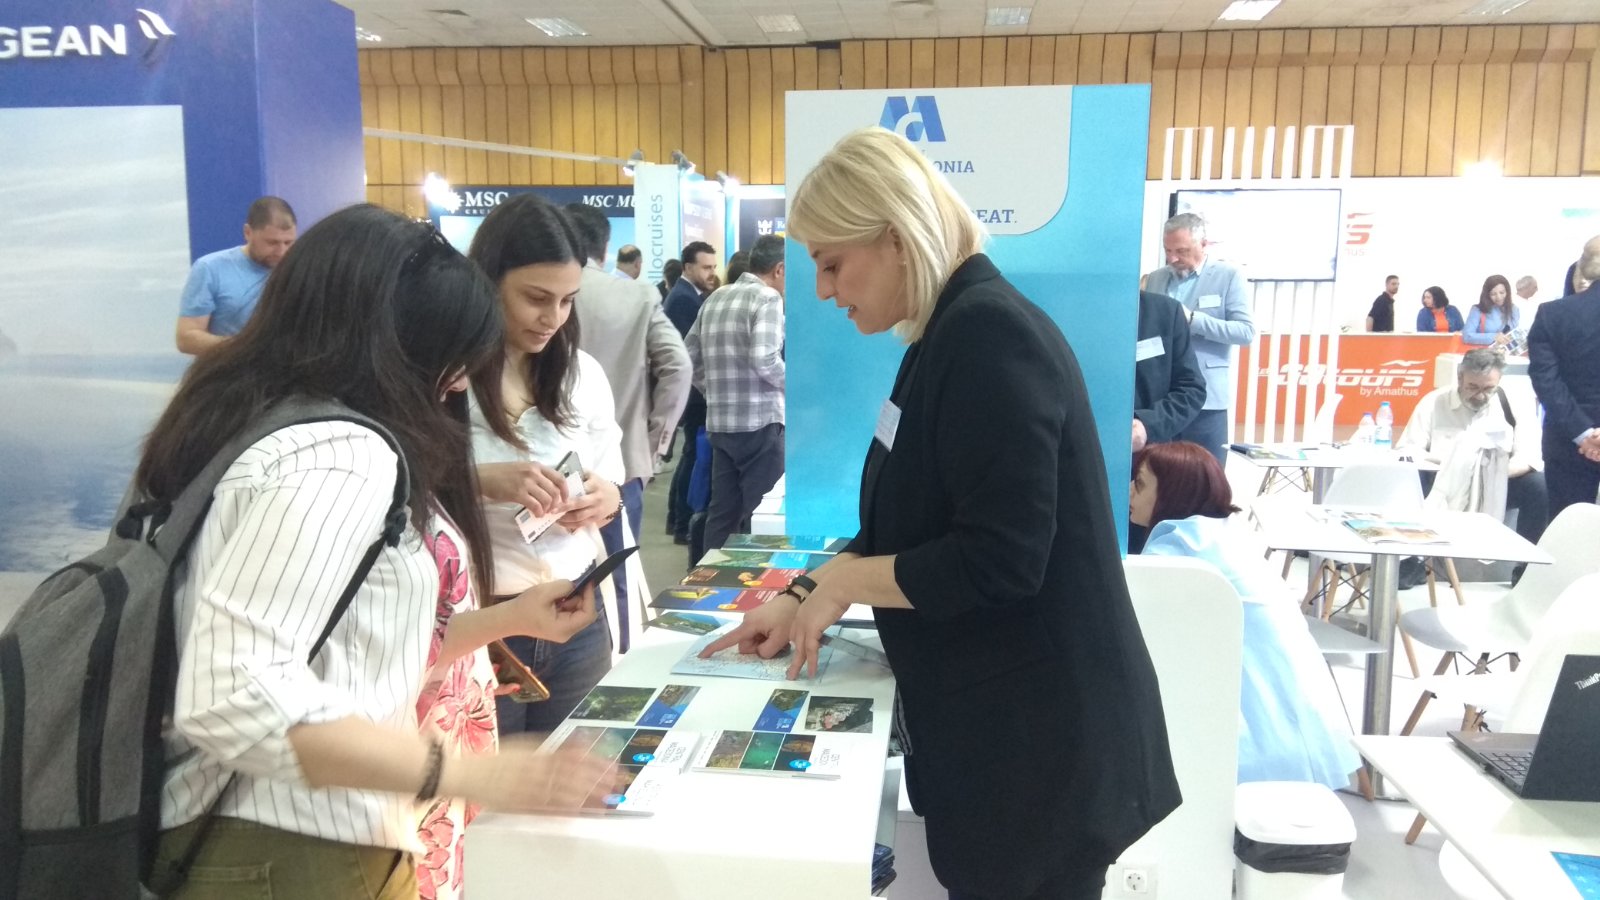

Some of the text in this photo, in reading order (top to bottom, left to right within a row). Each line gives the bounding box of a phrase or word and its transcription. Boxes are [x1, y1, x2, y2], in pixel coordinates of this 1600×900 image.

[465, 191, 509, 207] MSC
[582, 194, 614, 208] MSC
[972, 209, 1018, 224] EAT.
[1359, 386, 1418, 397] by Amathus
[1574, 672, 1600, 690] ThinkP
